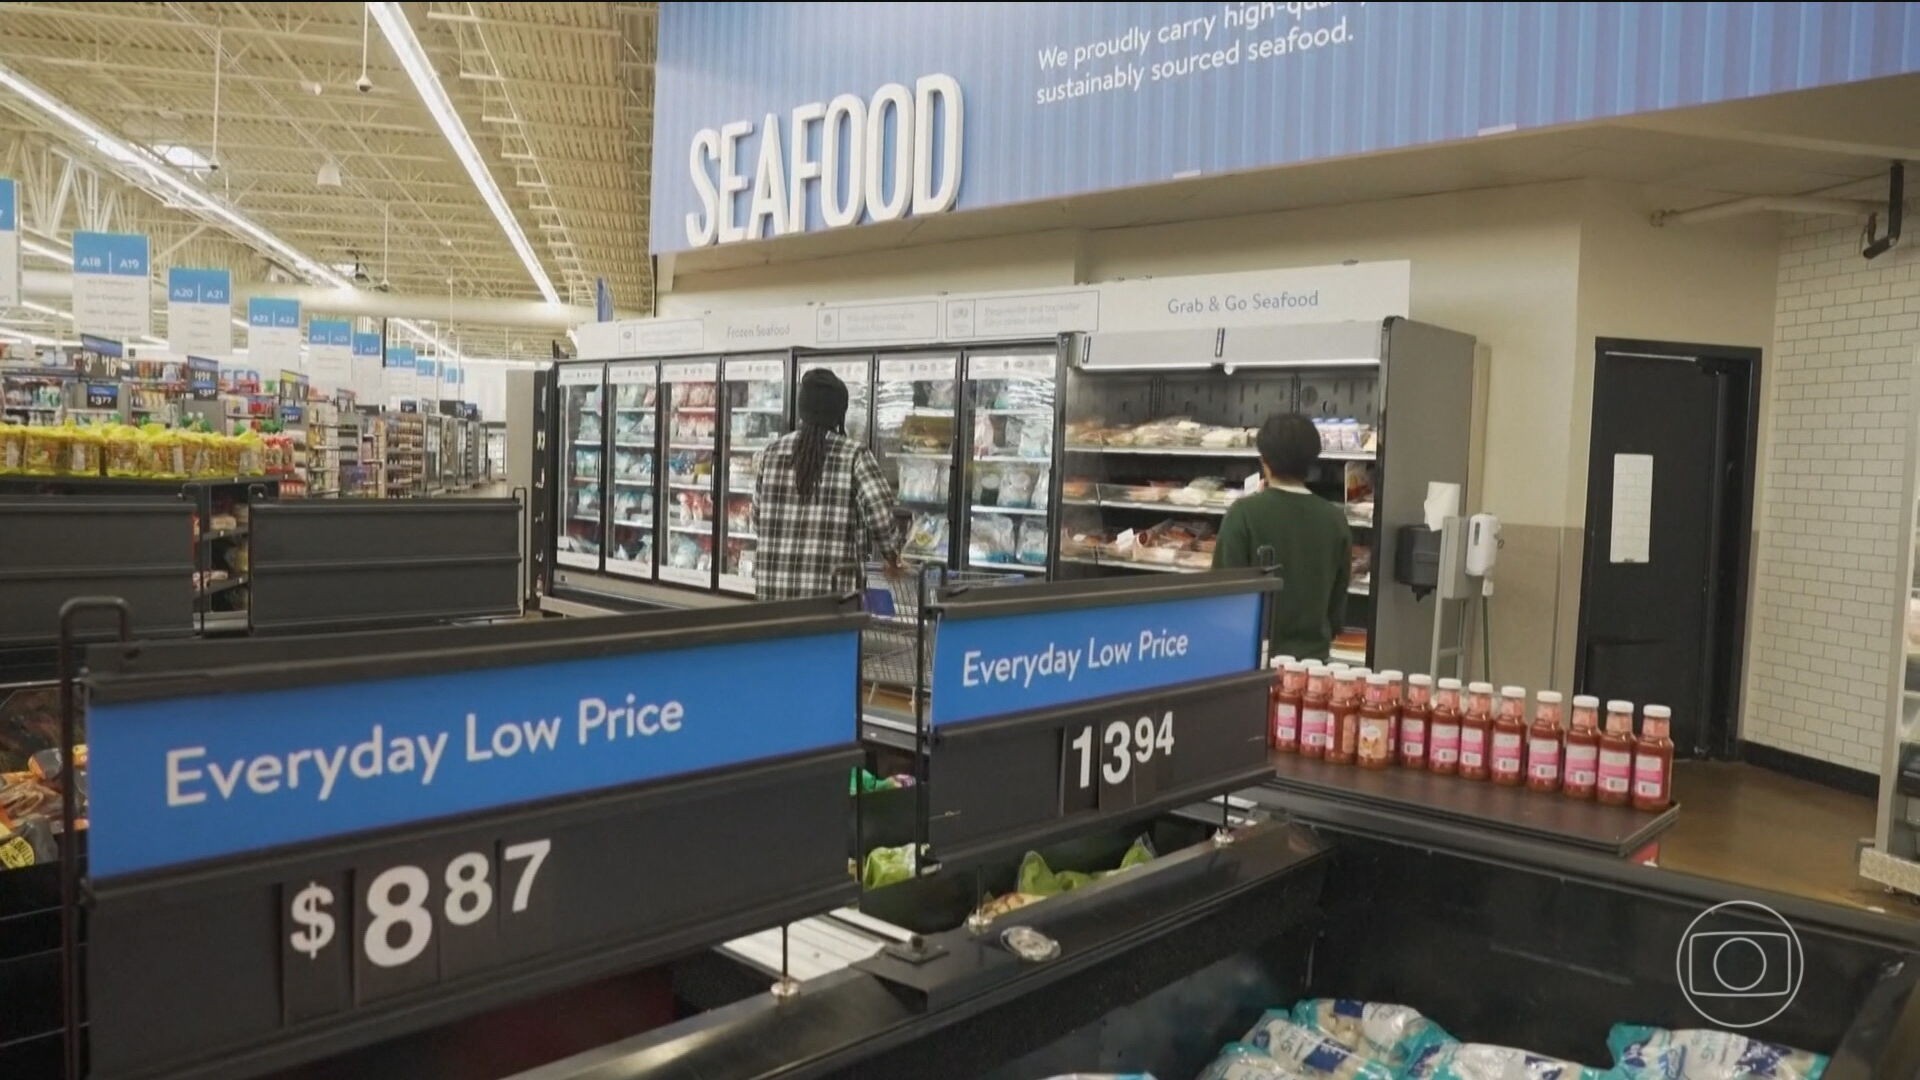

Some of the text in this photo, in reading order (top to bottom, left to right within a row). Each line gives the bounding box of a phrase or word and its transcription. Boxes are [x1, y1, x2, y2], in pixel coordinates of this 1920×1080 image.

[1036, 16, 1354, 105] sustainably sourced seafood.
[1037, 46, 1068, 71] We
[1074, 27, 1151, 69] proudly
[1158, 15, 1216, 43] carry
[685, 72, 964, 248] SEAFOOD
[119, 258, 140, 269] A19
[173, 288, 193, 298] A20
[206, 290, 224, 299] A21
[1167, 289, 1319, 315] Grab & Go Seafood
[727, 323, 790, 339] Frozen Seafood
[962, 628, 1188, 689] Everyday Low Price
[165, 694, 685, 808] Everyday Low Price
